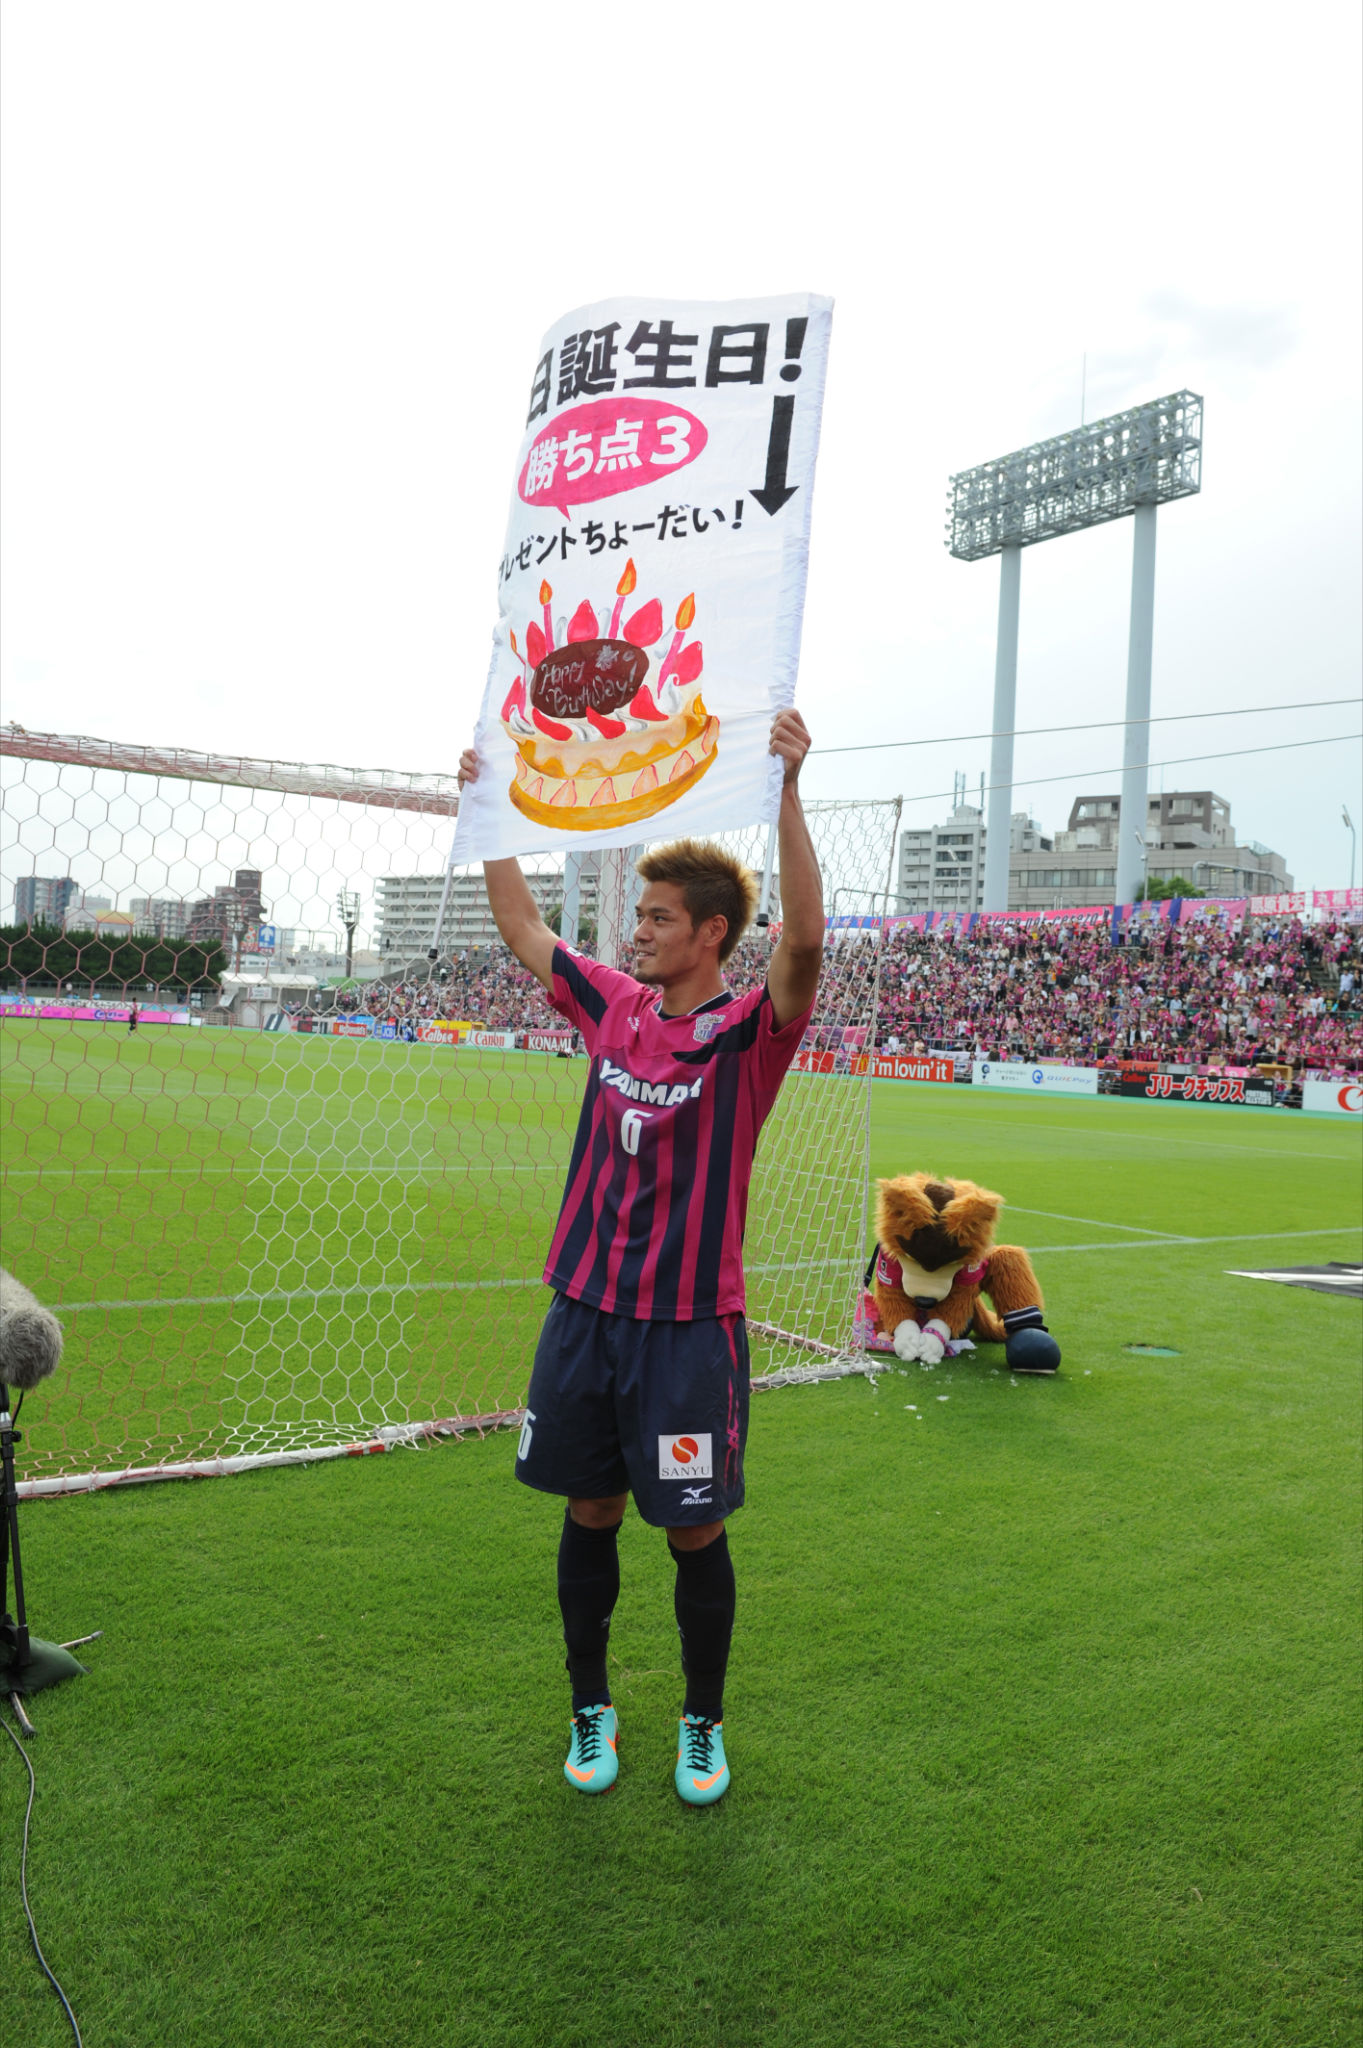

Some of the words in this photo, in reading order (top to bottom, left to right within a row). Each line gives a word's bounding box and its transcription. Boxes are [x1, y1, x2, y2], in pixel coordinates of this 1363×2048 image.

[524, 415, 691, 497] 勝ち点3
[422, 1029, 454, 1043] Calbee
[474, 1032, 505, 1047] Canon
[528, 1035, 572, 1051] KONAMI
[894, 1060, 934, 1079] lovin'
[935, 1061, 947, 1081] it
[1145, 1073, 1245, 1102] Jリーグチップス
[621, 1108, 654, 1156] 6
[661, 1466, 710, 1477] SANYU
